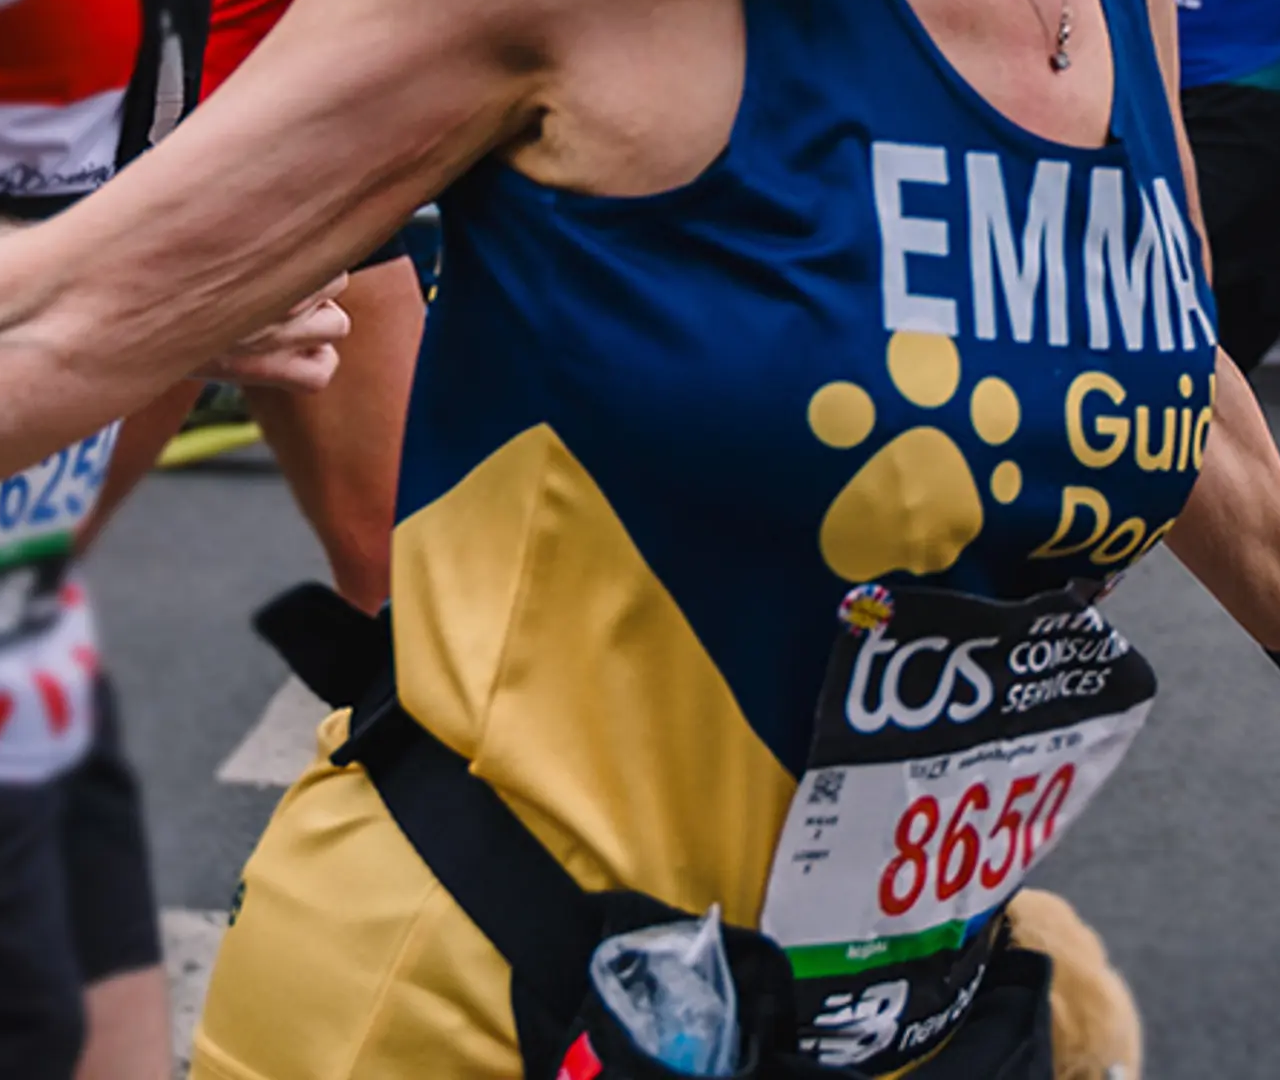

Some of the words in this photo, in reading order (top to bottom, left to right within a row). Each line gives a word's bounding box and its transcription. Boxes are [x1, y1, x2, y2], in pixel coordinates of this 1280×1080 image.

[871, 141, 1217, 352] EMMA
[846, 624, 1000, 734] tcs
[878, 763, 1076, 918] 8650
